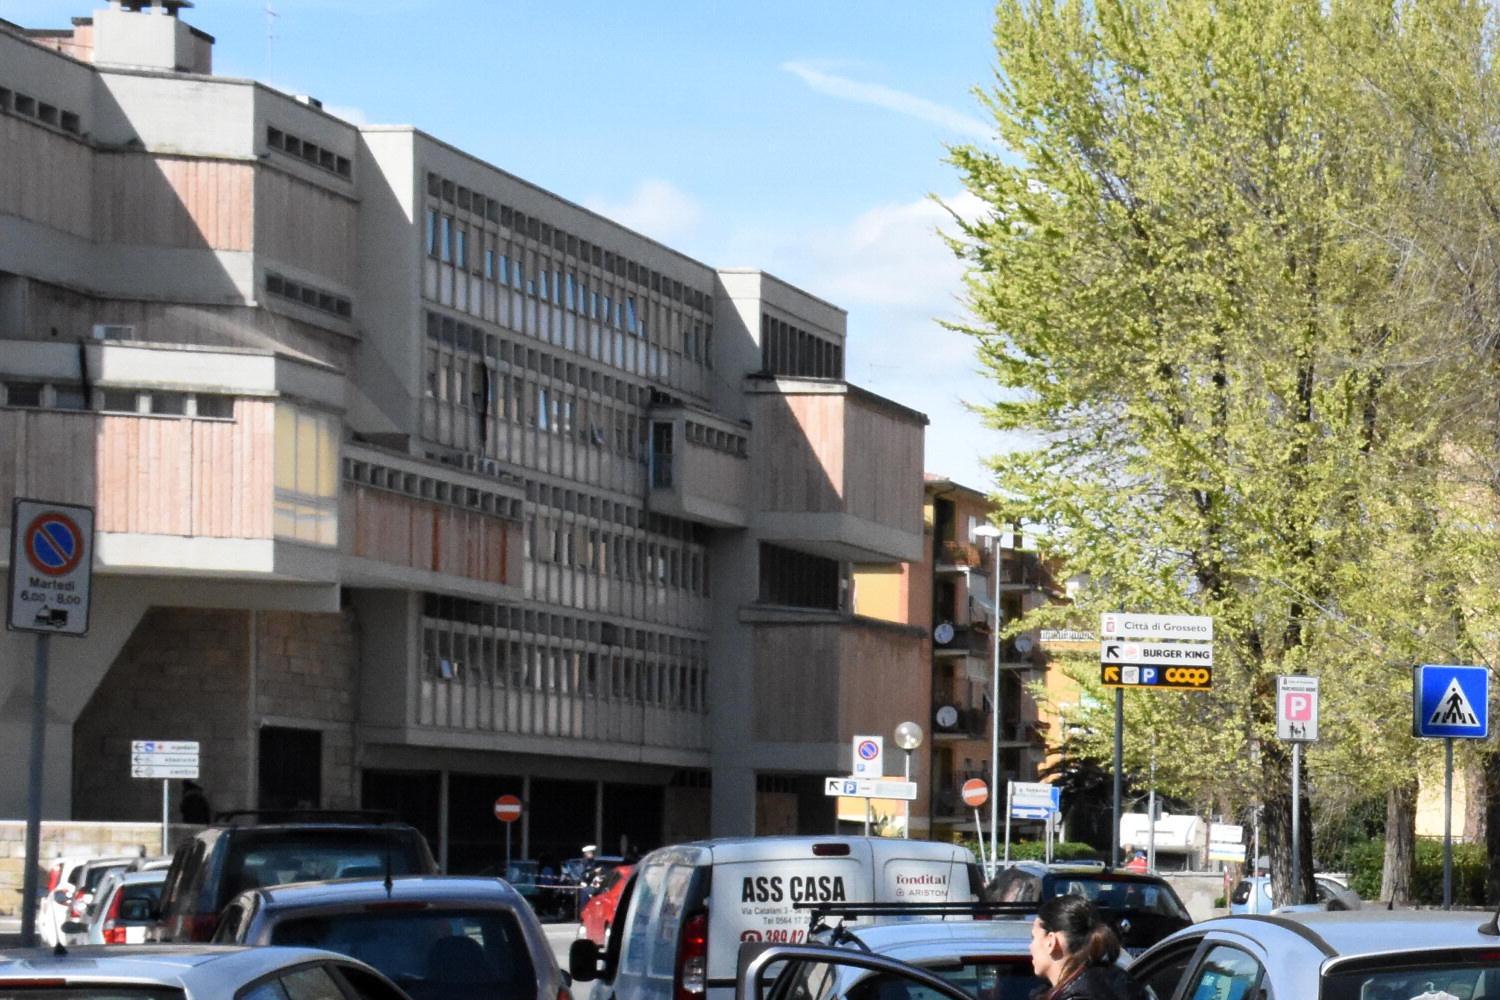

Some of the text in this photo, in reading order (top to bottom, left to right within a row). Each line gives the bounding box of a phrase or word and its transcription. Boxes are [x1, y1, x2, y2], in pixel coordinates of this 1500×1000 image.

[1152, 622, 1161, 631] di
[1163, 622, 1207, 633] Grosseto
[1143, 648, 1210, 660] BURGER KING
[896, 874, 946, 885] fondital
[742, 875, 846, 902] ASS CASA
[908, 889, 948, 897] ARISTON
[766, 929, 788, 943] 389
